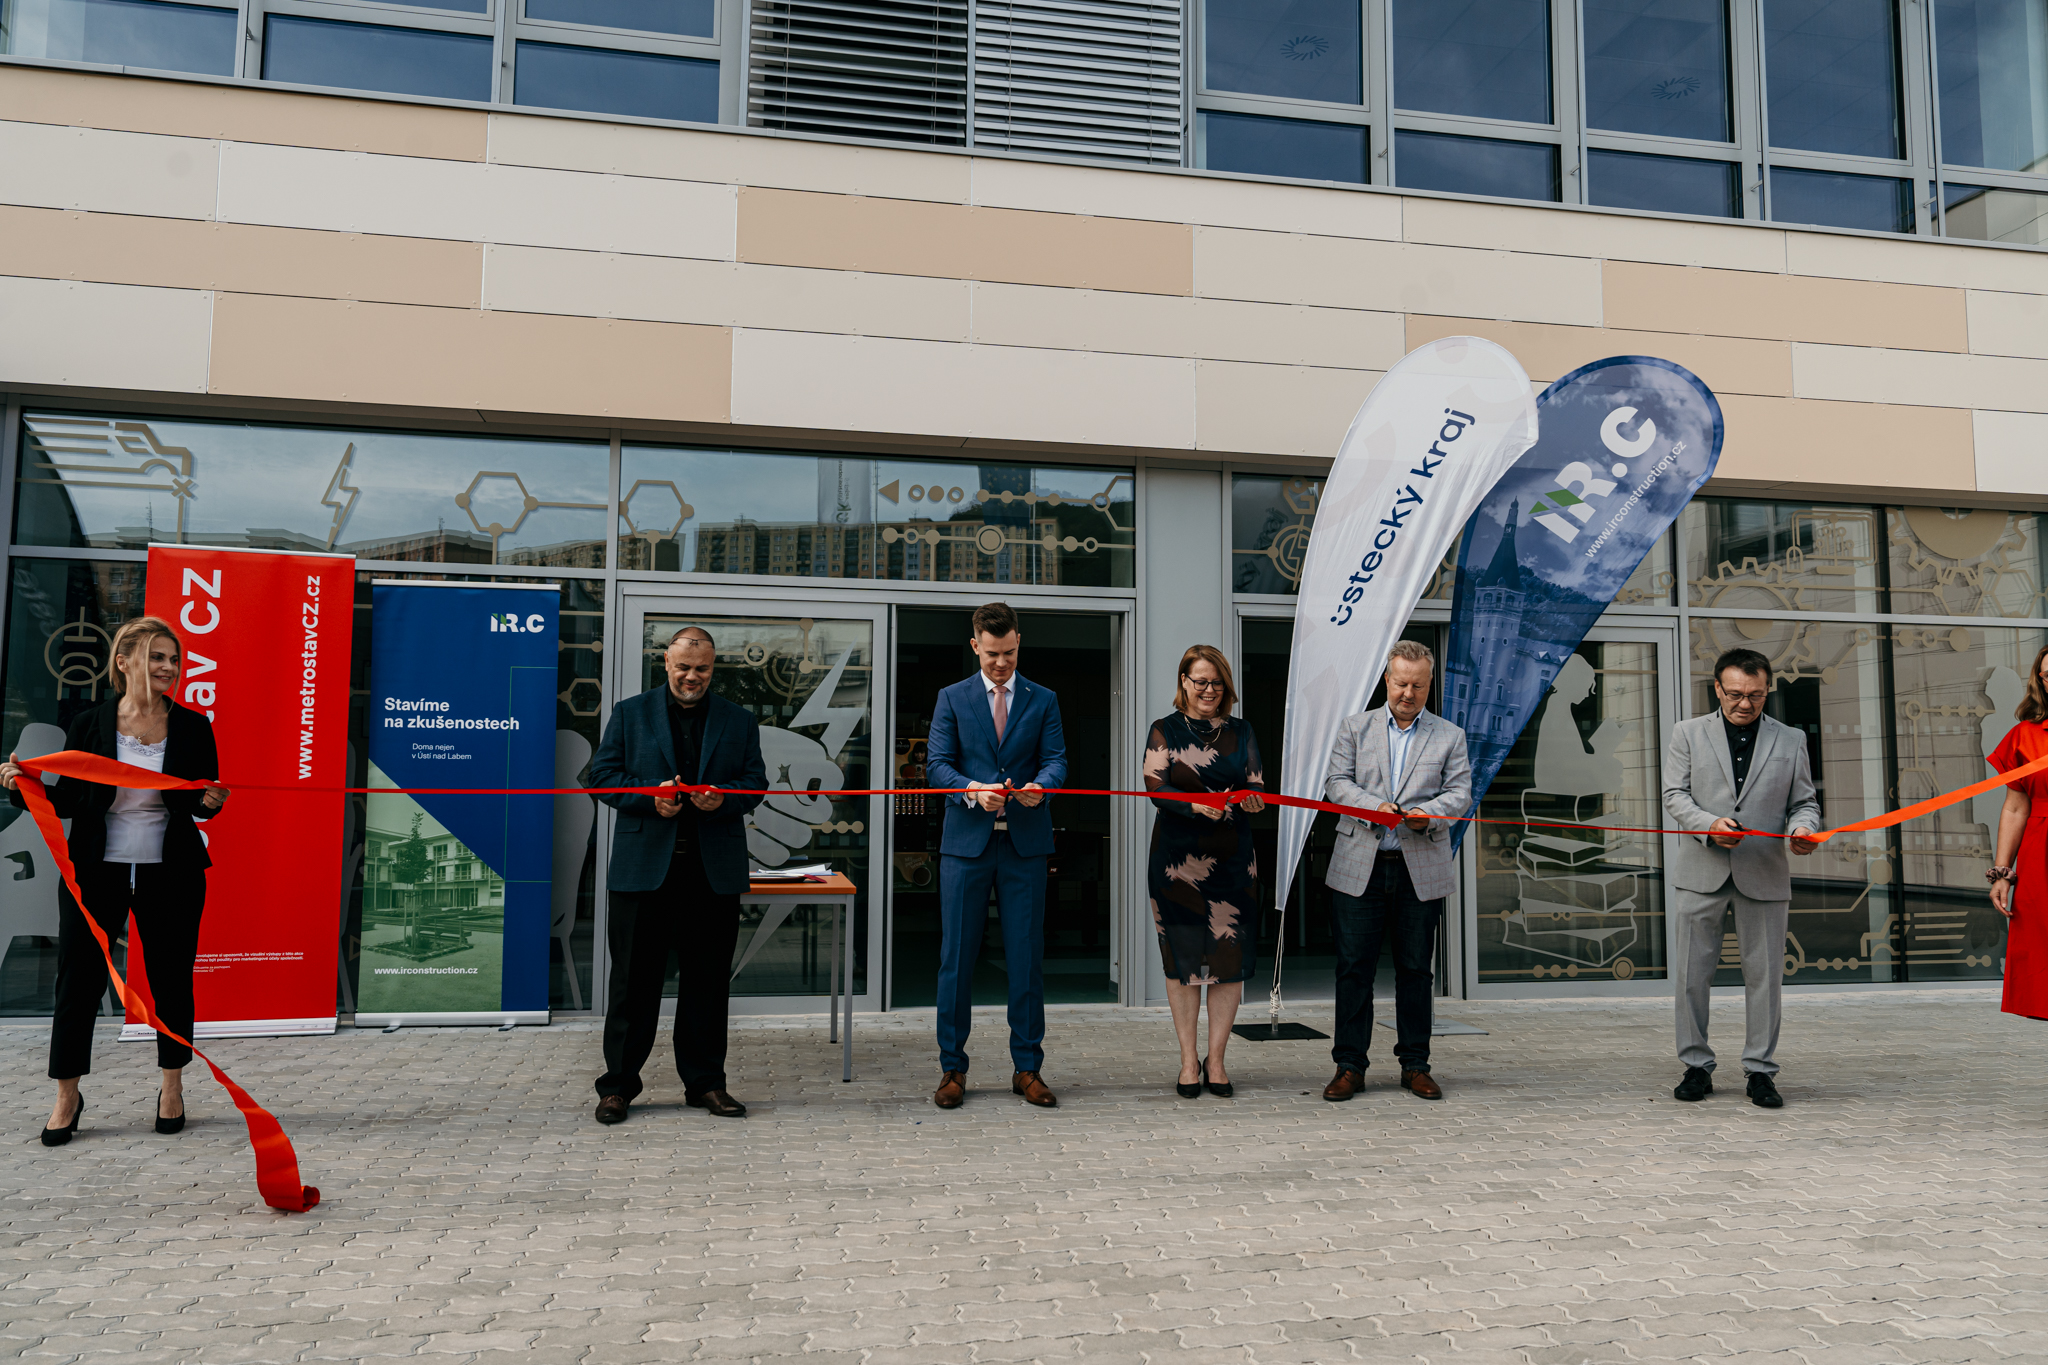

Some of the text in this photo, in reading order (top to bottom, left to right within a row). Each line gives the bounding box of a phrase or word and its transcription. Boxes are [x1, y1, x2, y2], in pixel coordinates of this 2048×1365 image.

[1409, 407, 1476, 479] kraj
[1584, 440, 1688, 558] www.irconstruction.cz
[180, 567, 222, 635] CZ
[298, 575, 321, 780] www.metrostavCZ.cz
[384, 697, 450, 712] Stavíme
[384, 715, 520, 731] na zkušenostech
[417, 751, 432, 759] Ústí
[435, 744, 455, 752] nejen
[374, 966, 478, 975] www.irconstruction.cz
